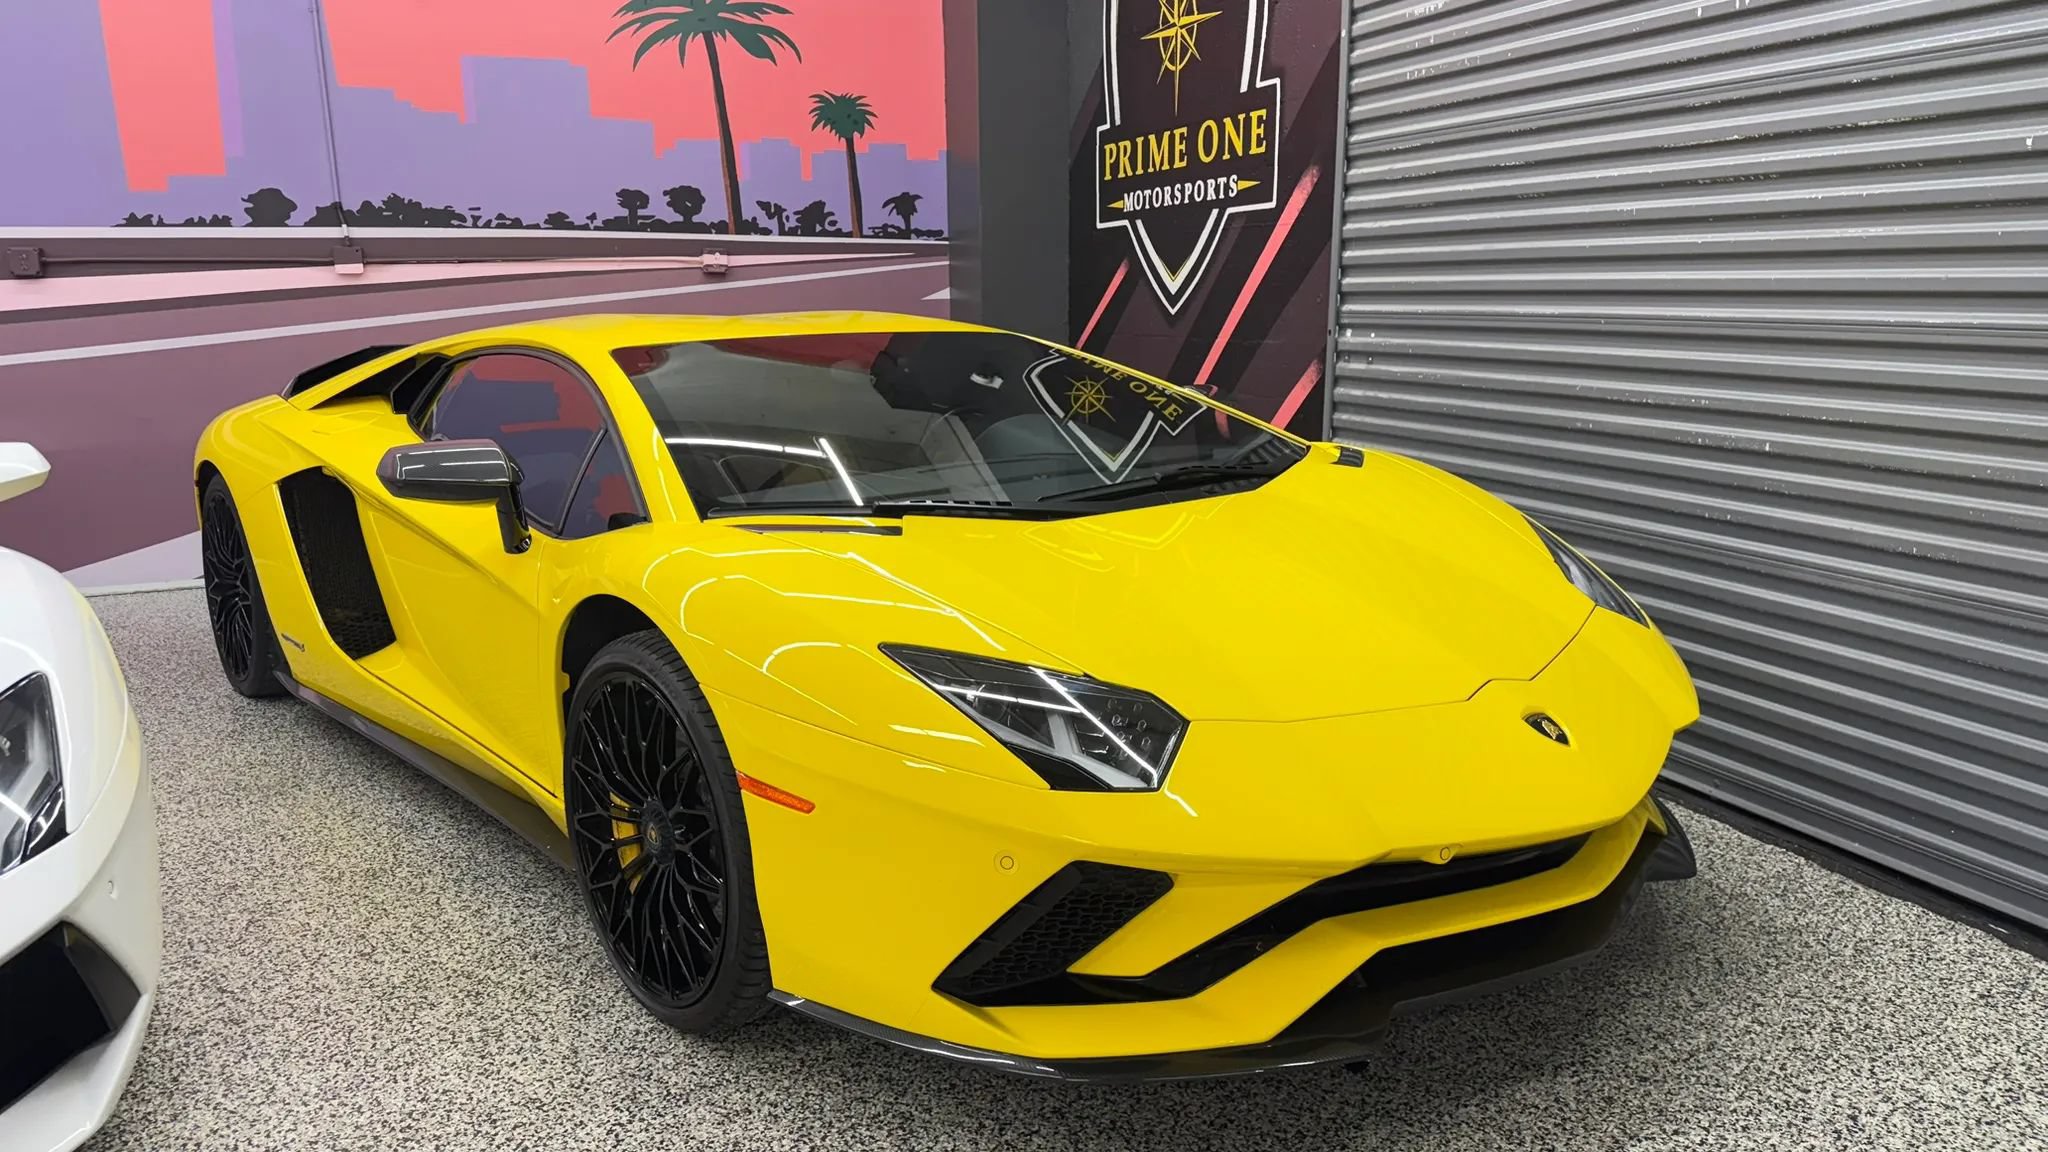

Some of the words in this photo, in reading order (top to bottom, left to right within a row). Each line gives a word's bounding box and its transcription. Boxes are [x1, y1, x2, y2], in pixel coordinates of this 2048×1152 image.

[1103, 127, 1188, 181] PRIME
[1197, 109, 1267, 163] ONE
[1123, 174, 1238, 213] MOTORSPORTS
